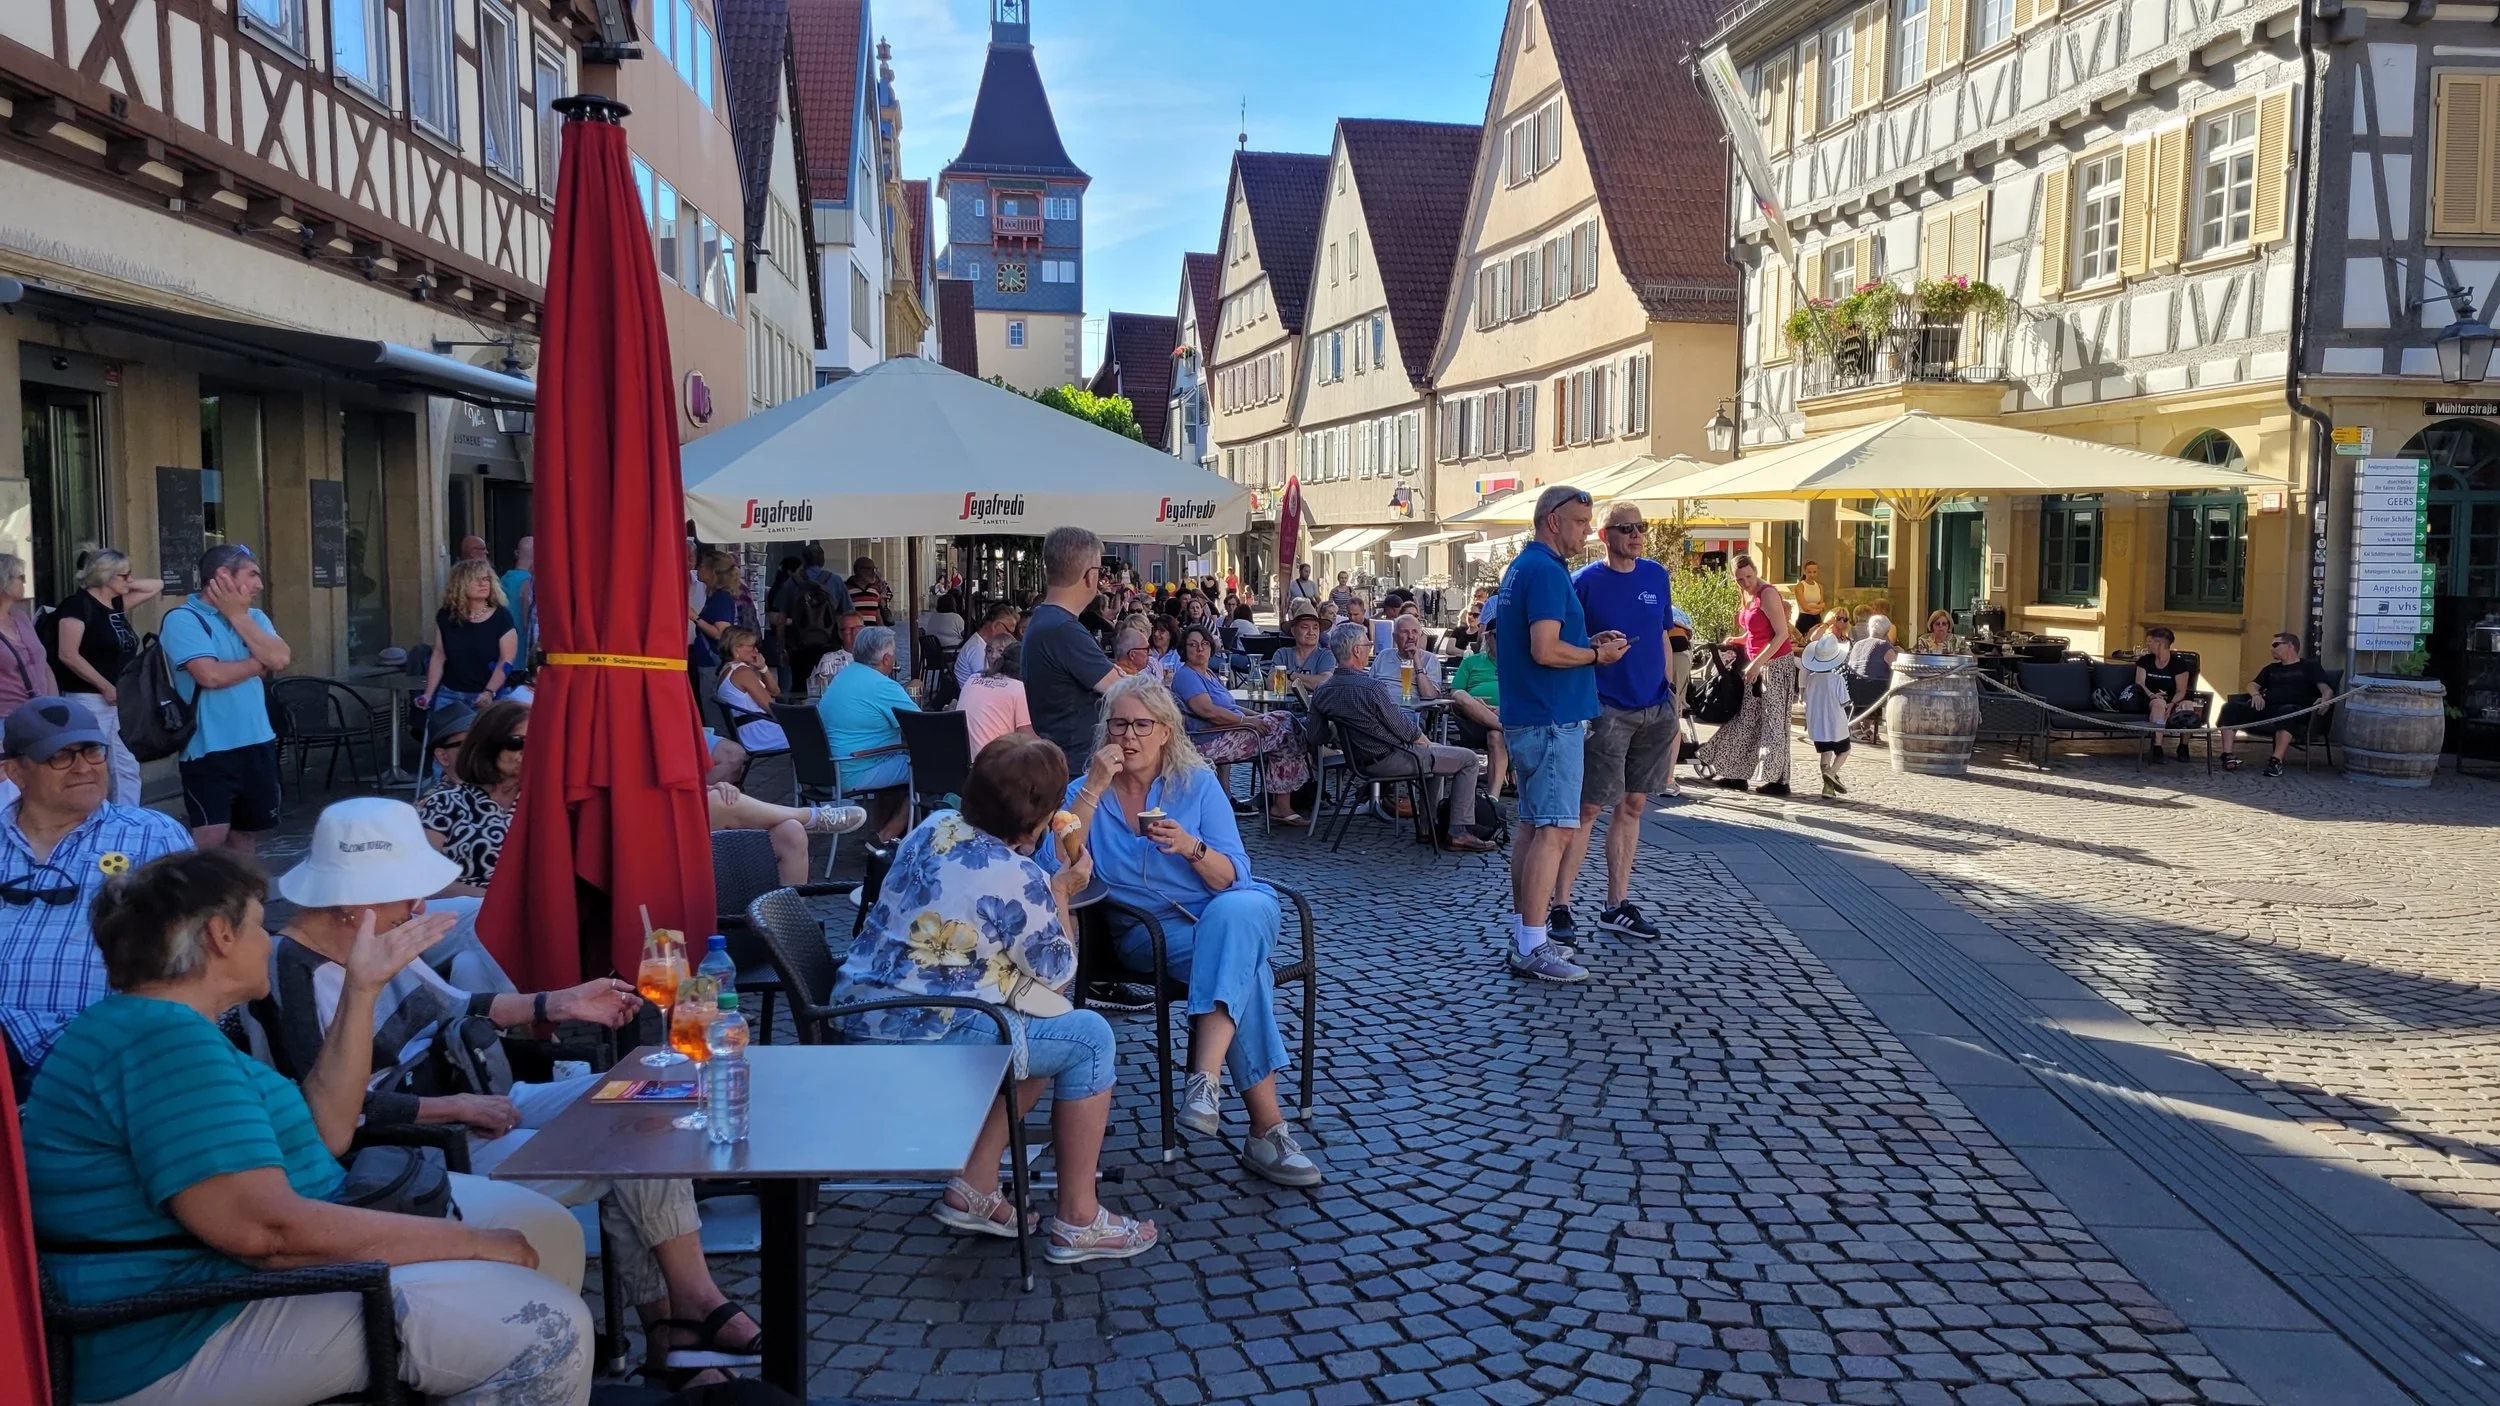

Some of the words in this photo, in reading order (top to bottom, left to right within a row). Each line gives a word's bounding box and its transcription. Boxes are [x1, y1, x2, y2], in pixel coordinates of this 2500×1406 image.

[2436, 402, 2498, 415] Mühltorstraße
[959, 492, 1024, 520] Segafredo
[2387, 498, 2413, 506] GEERS
[741, 499, 813, 528] Segafredo
[1156, 497, 1216, 522] Segafredo
[2373, 585, 2417, 593] Angelshop
[2398, 602, 2417, 611] vhs
